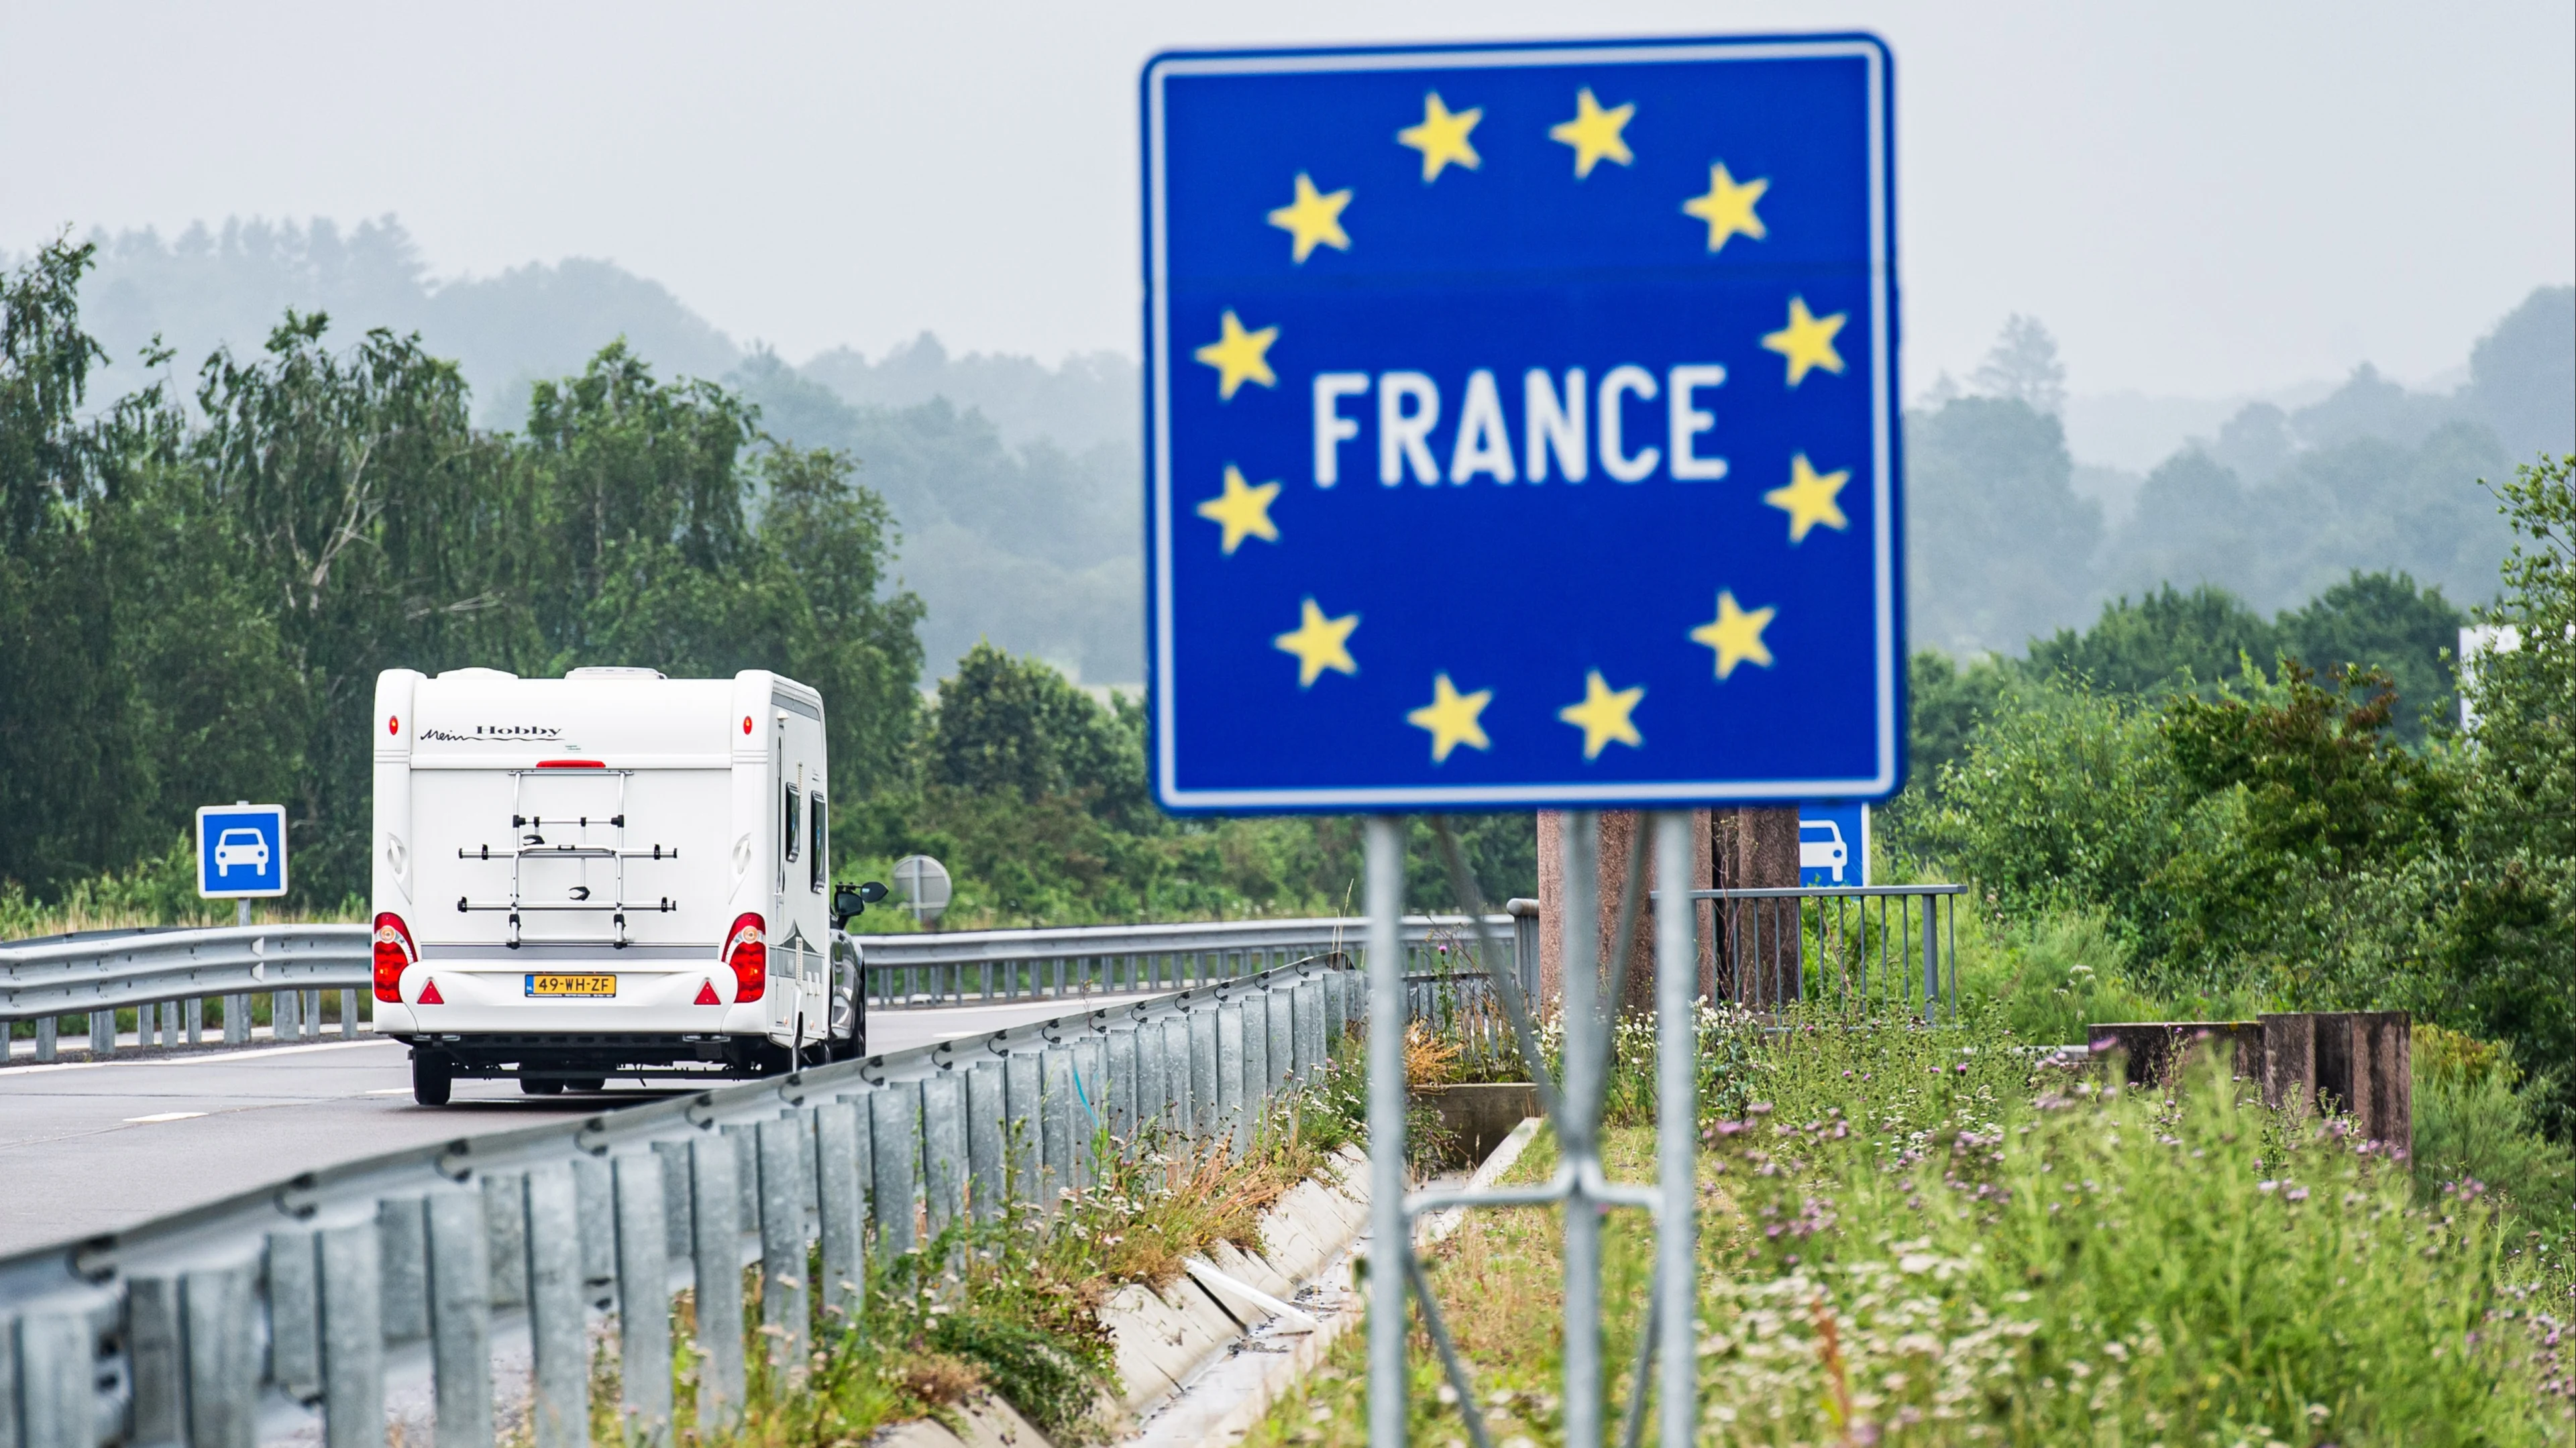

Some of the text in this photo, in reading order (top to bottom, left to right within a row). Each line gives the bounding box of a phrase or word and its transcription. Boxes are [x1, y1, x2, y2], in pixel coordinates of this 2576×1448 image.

[1313, 364, 1728, 488] FRANCE
[420, 726, 562, 741] Mein Hobby
[539, 978, 608, 991] 49-WH-ZF
